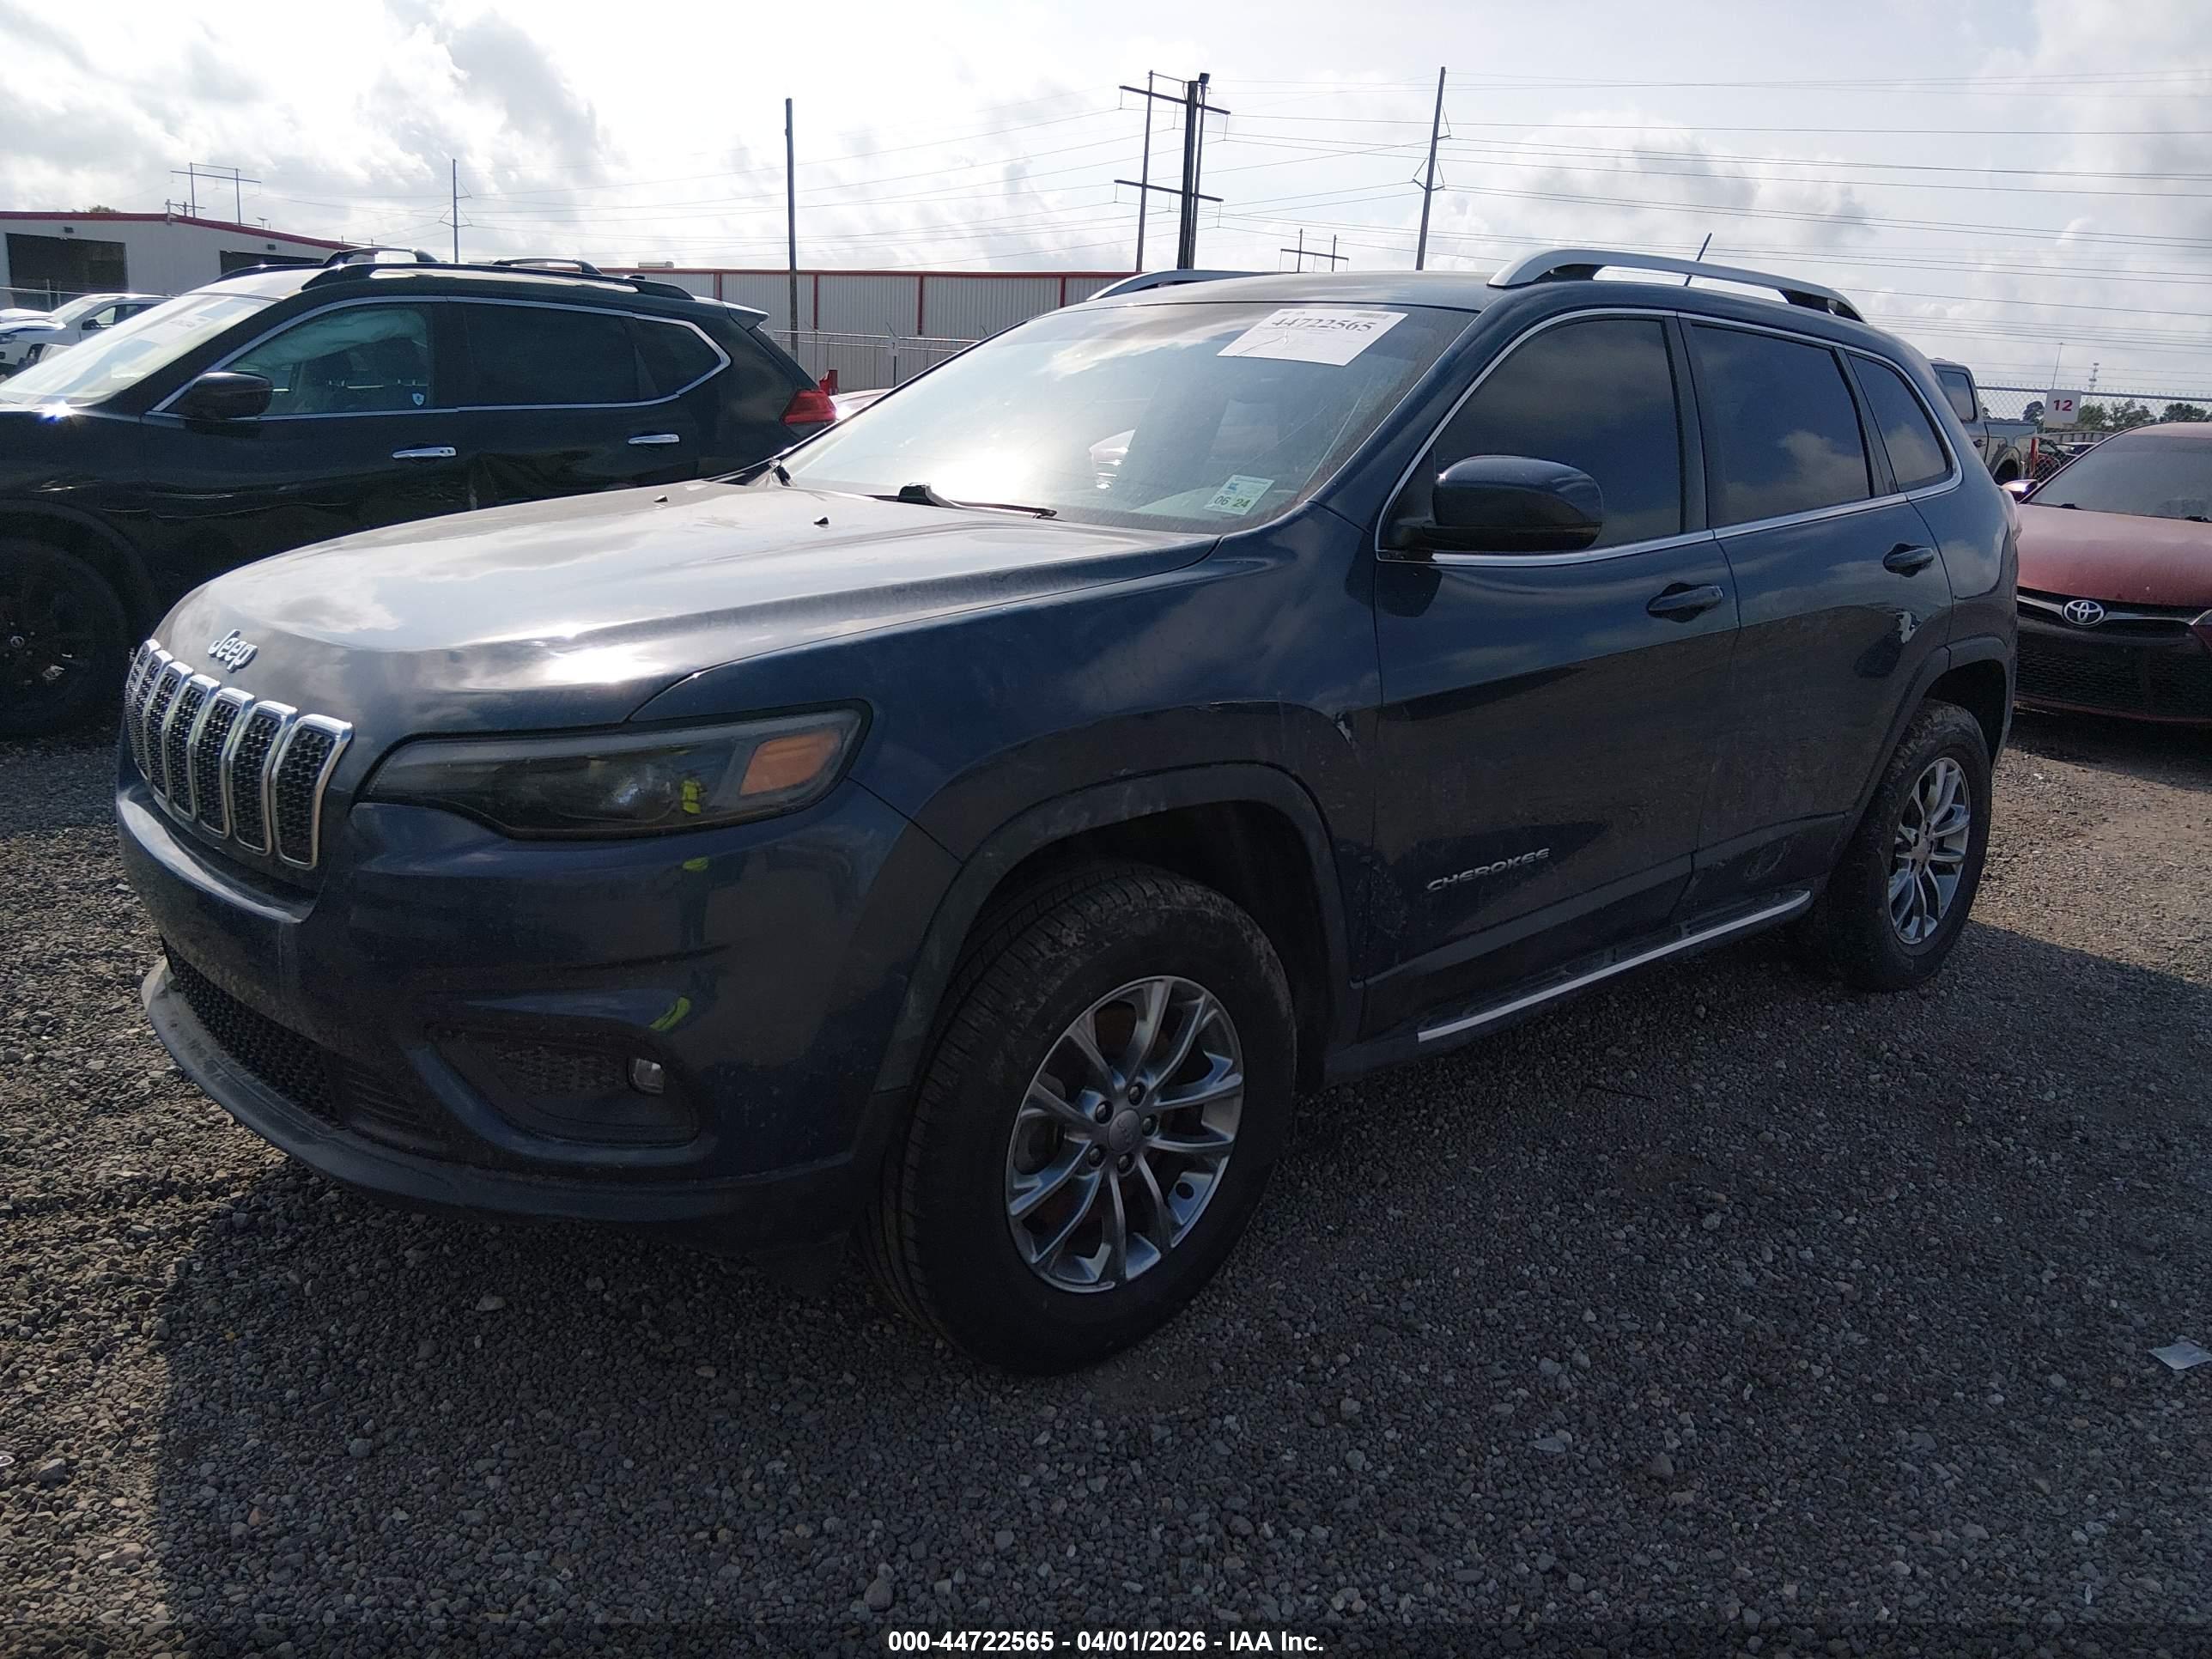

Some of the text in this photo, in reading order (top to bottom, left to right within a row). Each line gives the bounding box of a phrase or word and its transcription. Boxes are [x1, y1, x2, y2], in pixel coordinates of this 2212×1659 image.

[1271, 318, 1377, 331] 44722565
[2053, 398, 2073, 412] 12
[1214, 495, 1251, 508] 06 24
[208, 629, 258, 673] Jeep
[1426, 847, 1551, 891] CHEROKEE
